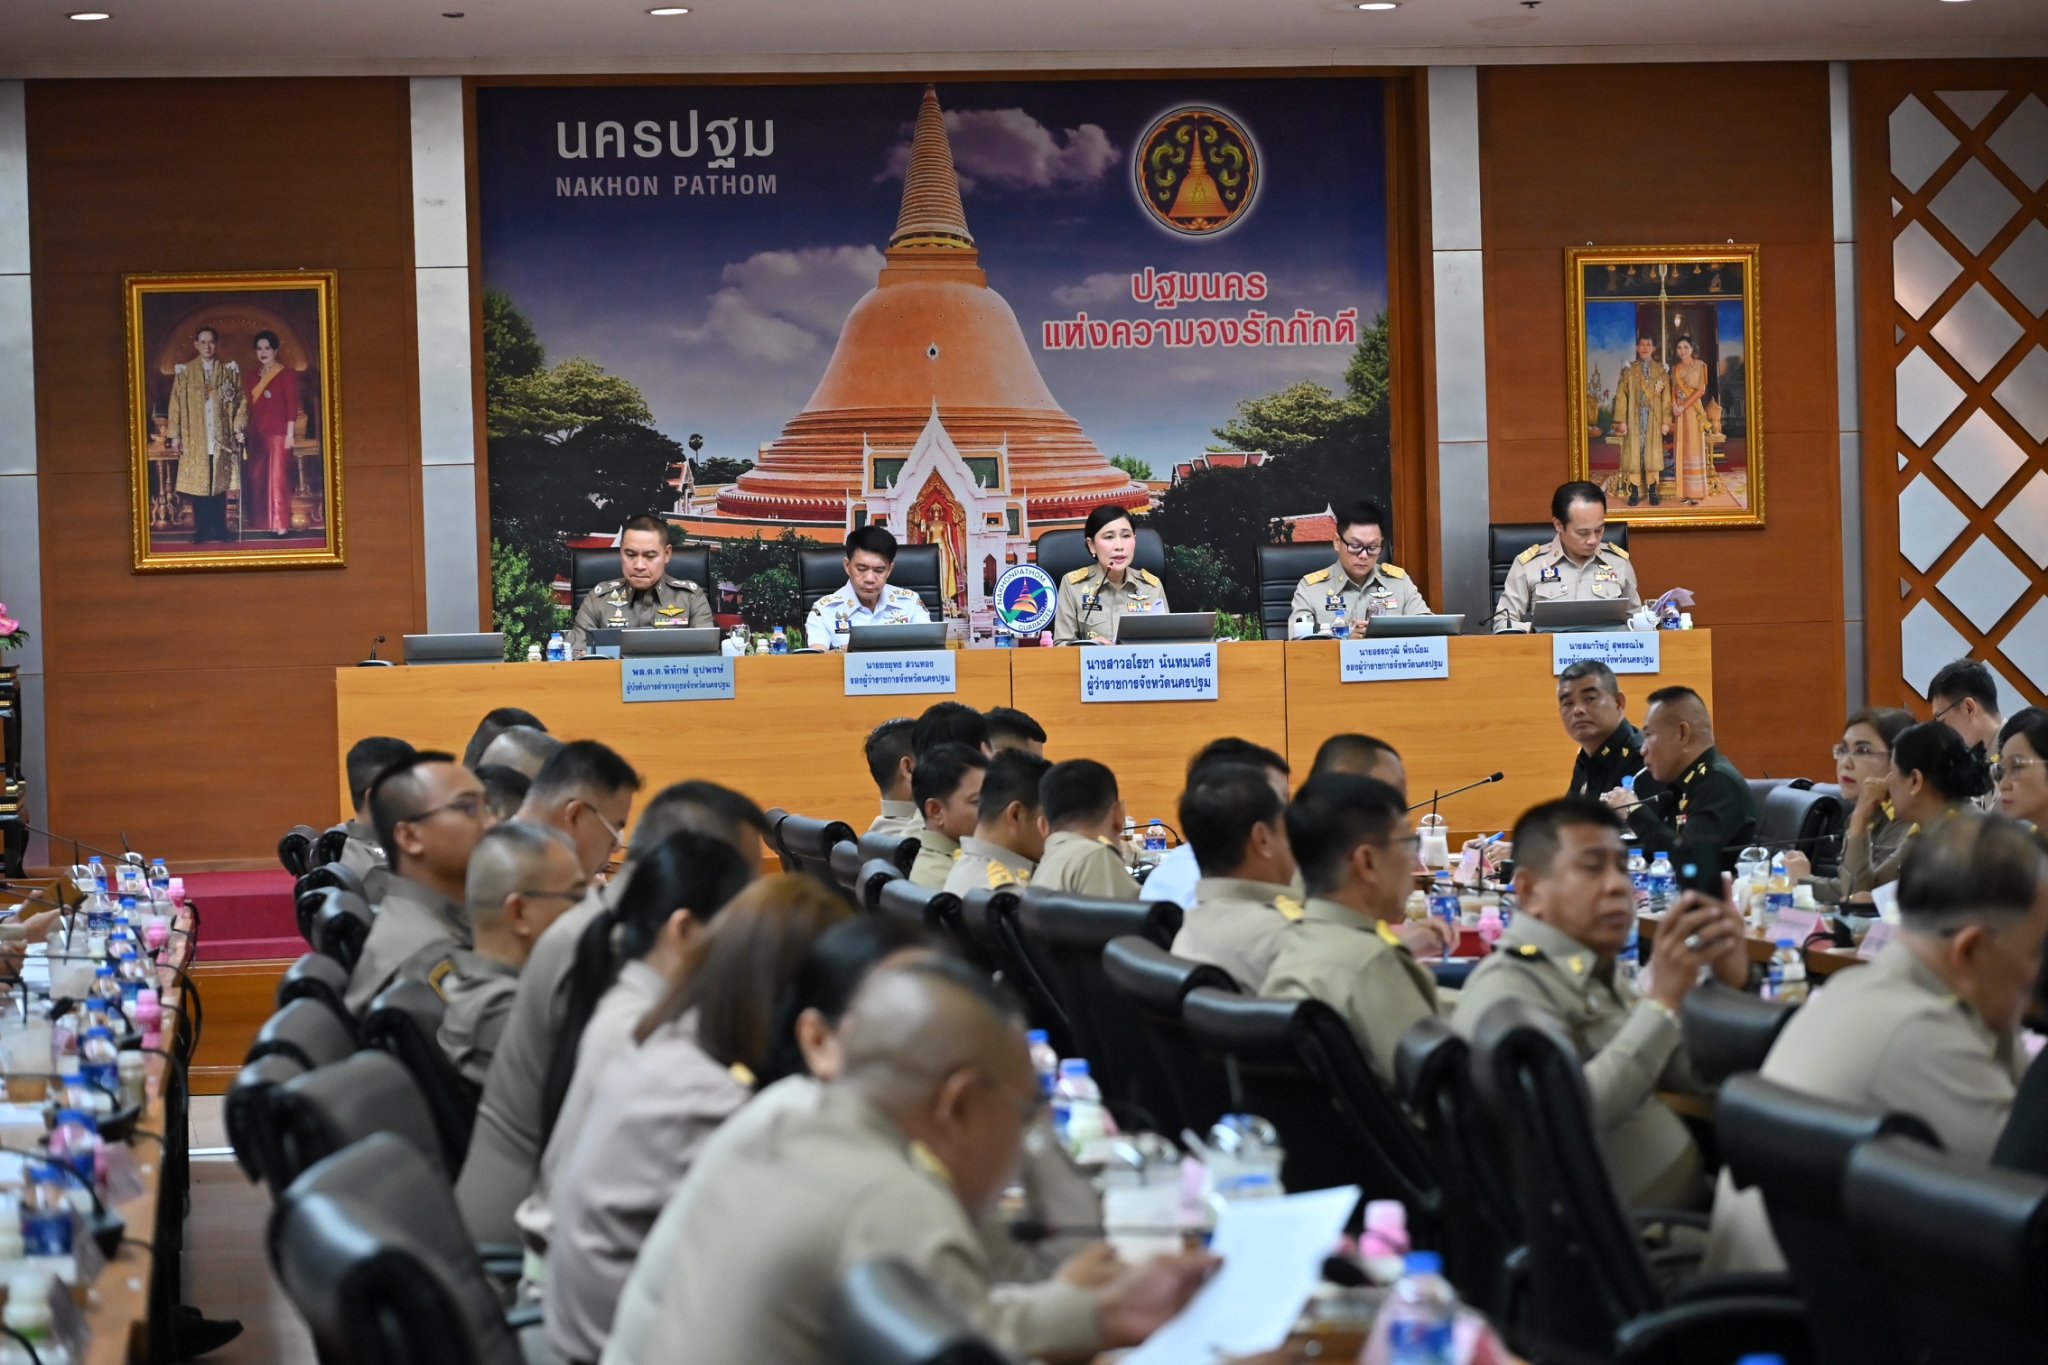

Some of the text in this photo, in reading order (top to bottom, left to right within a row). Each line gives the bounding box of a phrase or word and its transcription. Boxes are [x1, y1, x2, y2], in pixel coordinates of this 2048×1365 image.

[557, 109, 775, 168] นครปฐม
[556, 174, 777, 196] NAKHON PATHOM
[1132, 267, 1267, 309] ปฐมนคร
[1043, 307, 1357, 349] แห่งความจงรักภักดี
[997, 568, 1047, 605] NAKHONPATHOM
[1018, 608, 1052, 631] GUARANTEE
[866, 661, 902, 672] นายยงยุทธ
[1086, 652, 1211, 670] นางสาวอโรชา นันทมนตรี
[1346, 659, 1443, 674] รองผู้ว่าราชการจังหวัดนครปฐม
[626, 680, 731, 694] ผู้บังคับการตำรวจภูธรจังหวัดนครปฐม
[850, 673, 950, 687] รองผู้ว่าราชการจังหวัดนครปฐม
[1087, 674, 1211, 696] ผู้ว่าราชการจังหวัดนครปฐม
